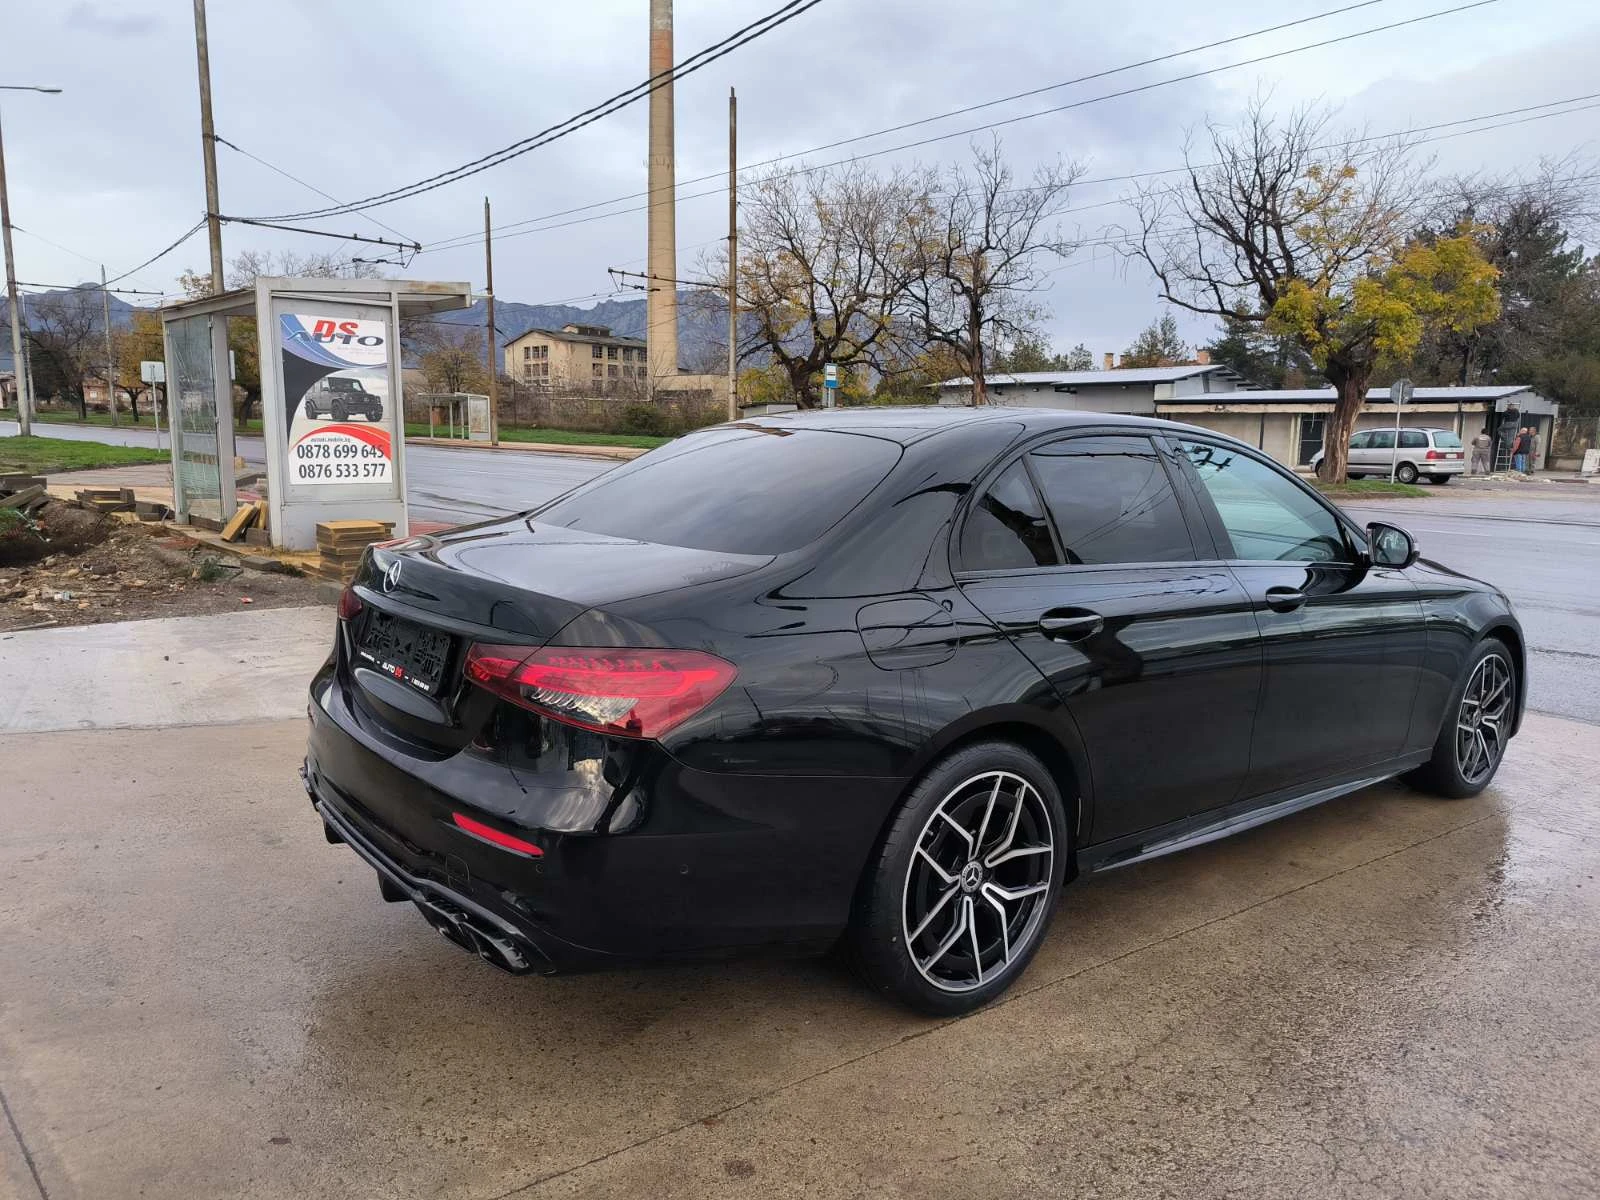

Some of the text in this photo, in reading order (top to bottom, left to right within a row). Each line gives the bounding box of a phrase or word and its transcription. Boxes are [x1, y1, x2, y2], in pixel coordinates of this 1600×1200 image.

[313, 319, 359, 337] DS
[297, 444, 385, 459] 0878 699 645
[299, 463, 386, 478] 0876 533 577
